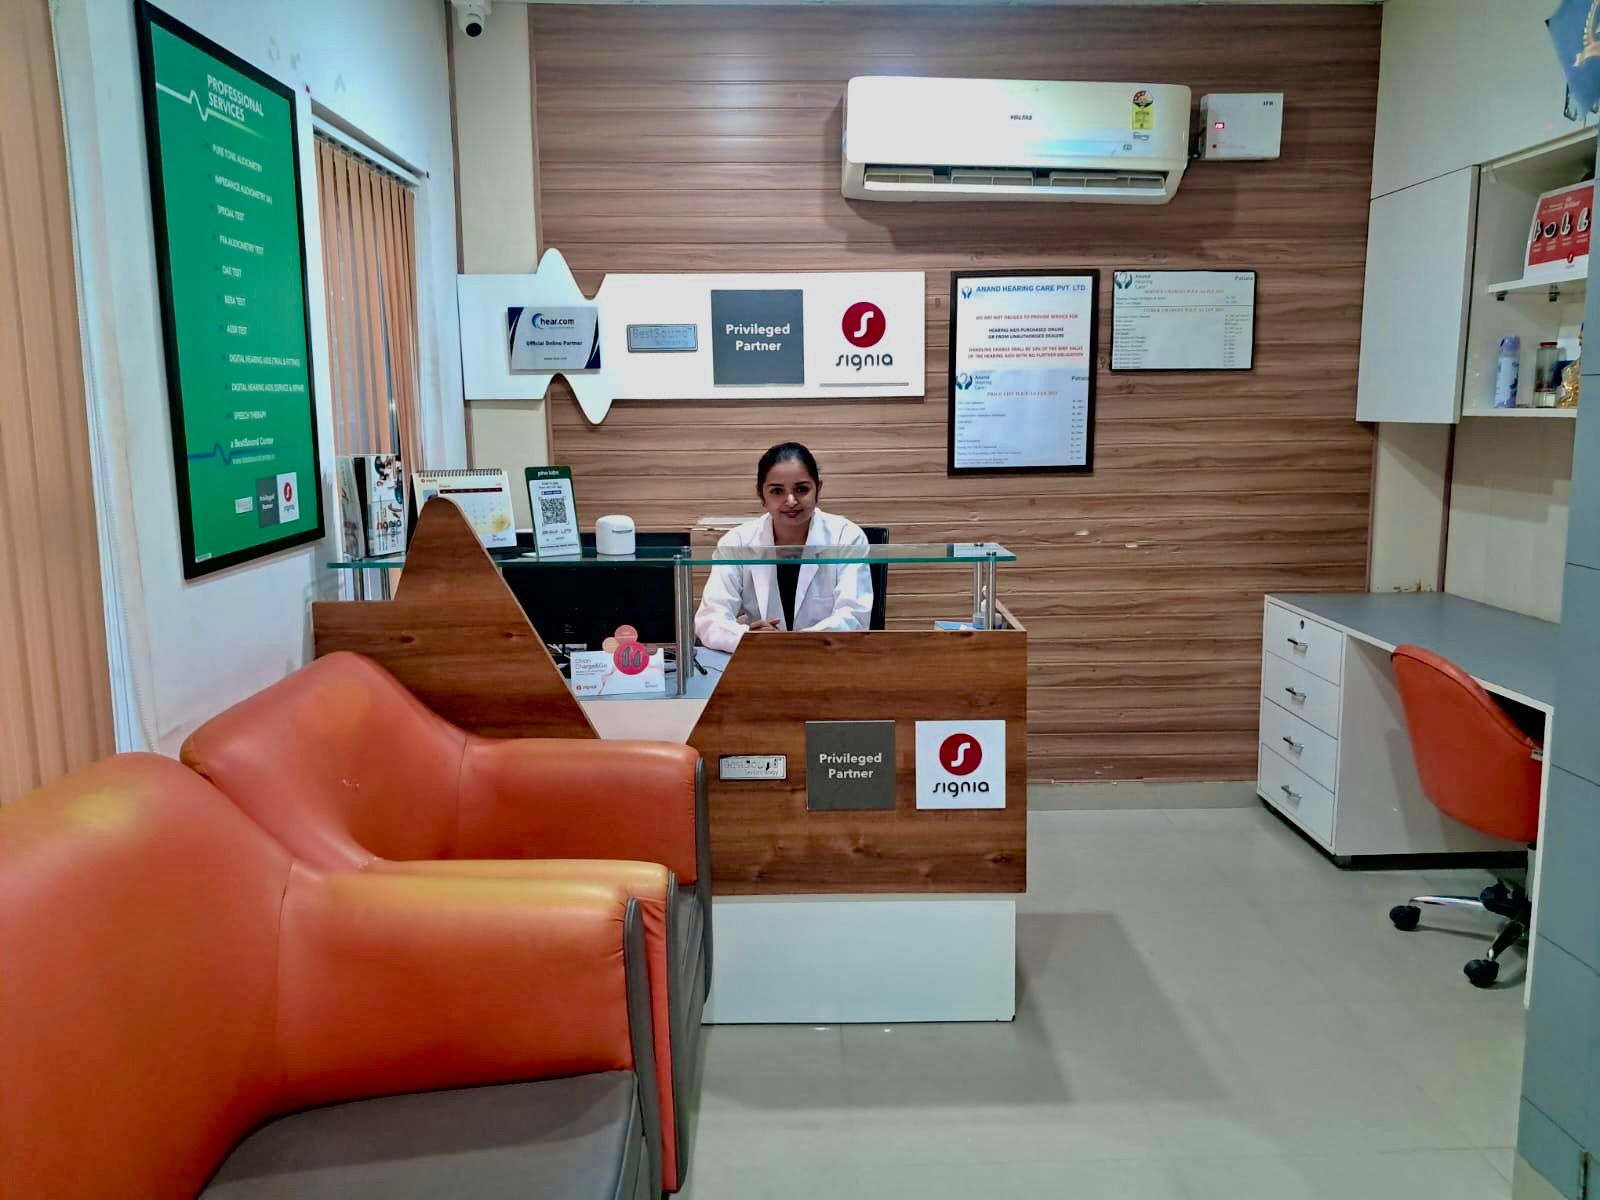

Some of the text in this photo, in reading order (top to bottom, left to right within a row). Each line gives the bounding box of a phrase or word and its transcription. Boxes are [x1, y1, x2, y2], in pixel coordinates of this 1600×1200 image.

[207, 74, 264, 117] PROFESSIONAL
[208, 92, 245, 121] SERVICES
[976, 285, 1001, 293] ANAND
[1036, 284, 1055, 292] CARE
[540, 317, 575, 326] hear.com
[725, 323, 791, 338] Privileged
[735, 339, 782, 351] Partner
[835, 353, 893, 372] signia
[819, 752, 882, 766] Privileged
[828, 768, 874, 779] Partner
[932, 781, 990, 797] signia
